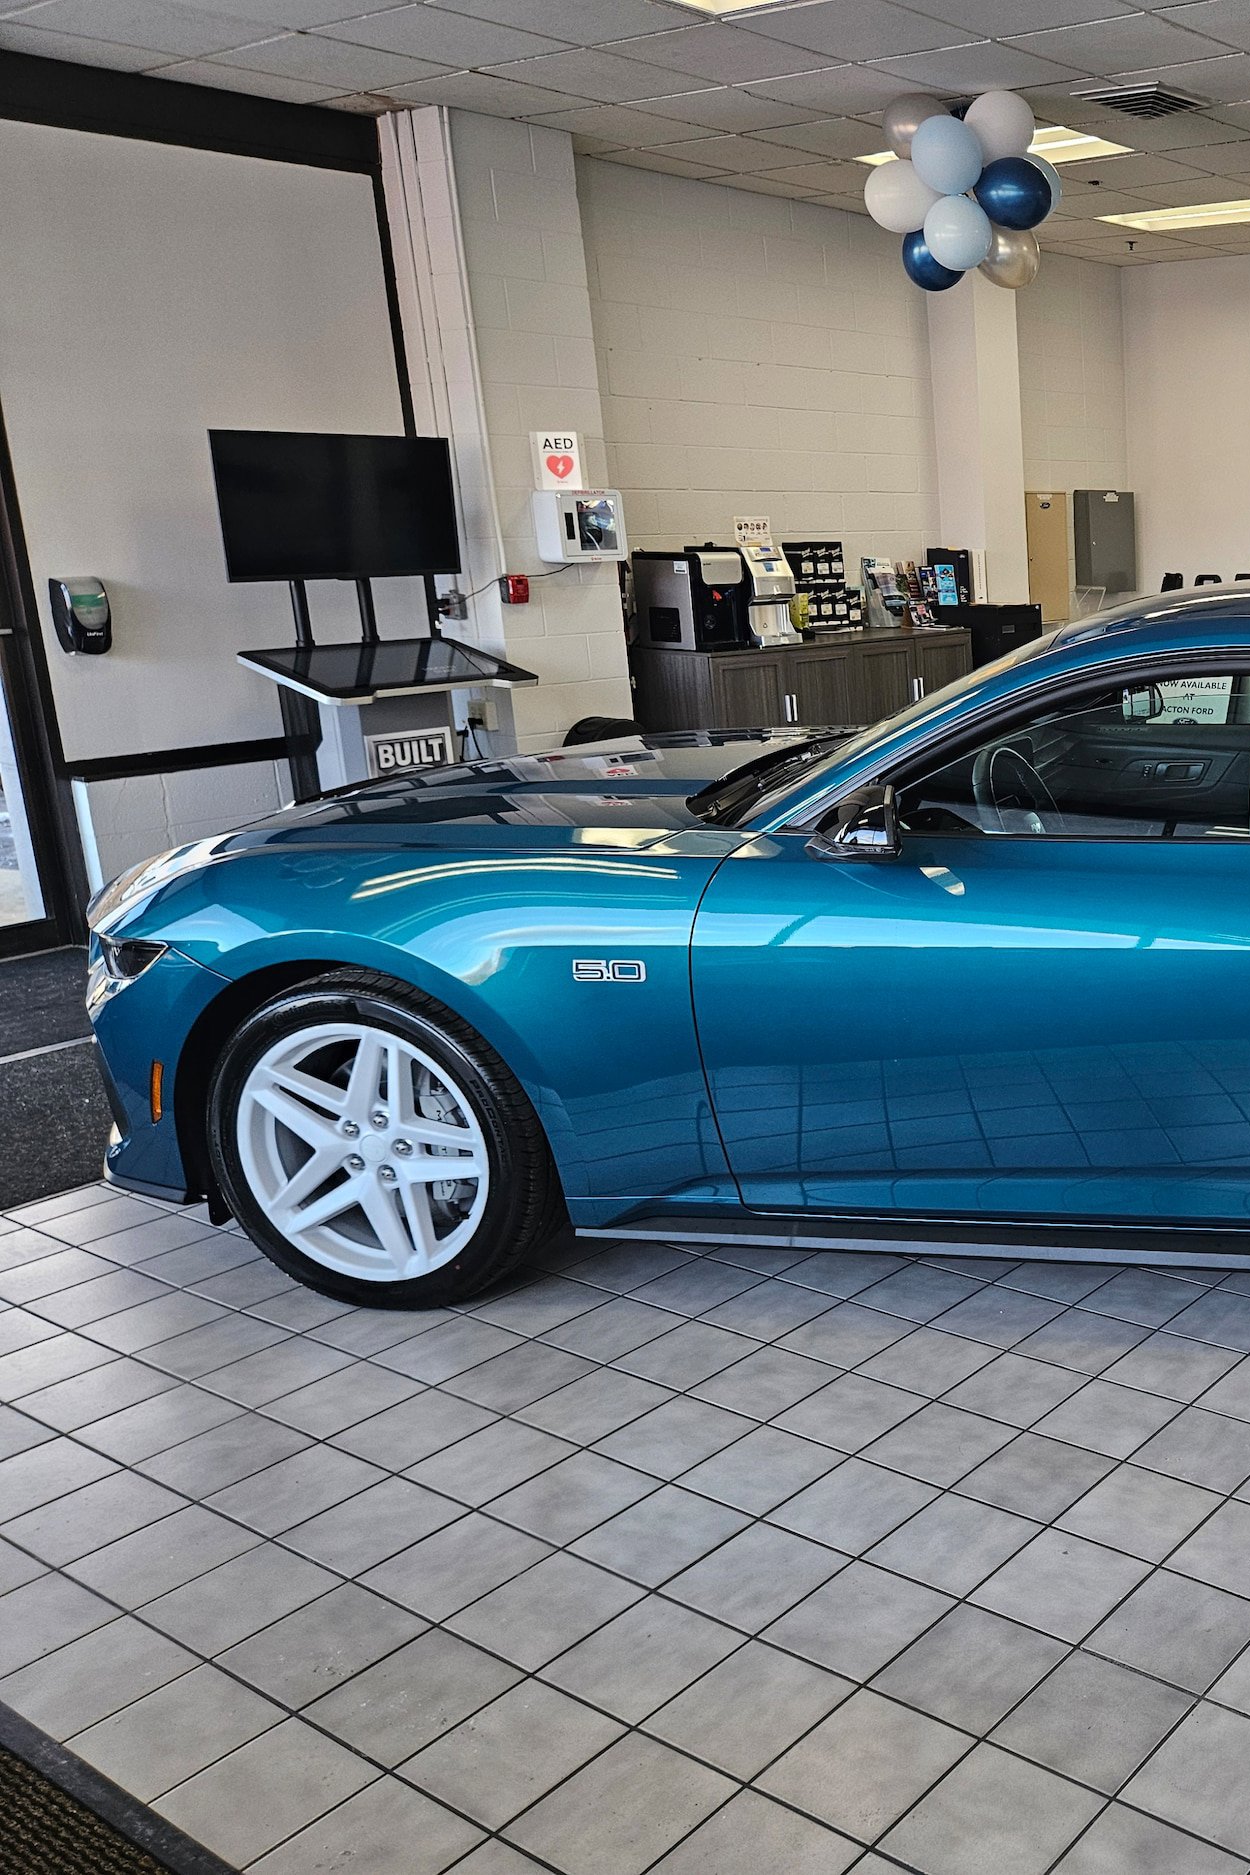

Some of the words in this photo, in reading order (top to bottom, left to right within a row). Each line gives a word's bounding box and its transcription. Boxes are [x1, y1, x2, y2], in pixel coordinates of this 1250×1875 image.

[543, 438, 574, 450] AED
[1180, 681, 1227, 690] AVAILABLE
[1183, 693, 1196, 701] AT
[1162, 706, 1190, 714] ACTON
[1191, 707, 1214, 715] FORD
[377, 737, 444, 770] BUILT
[572, 959, 647, 983] 5.0
